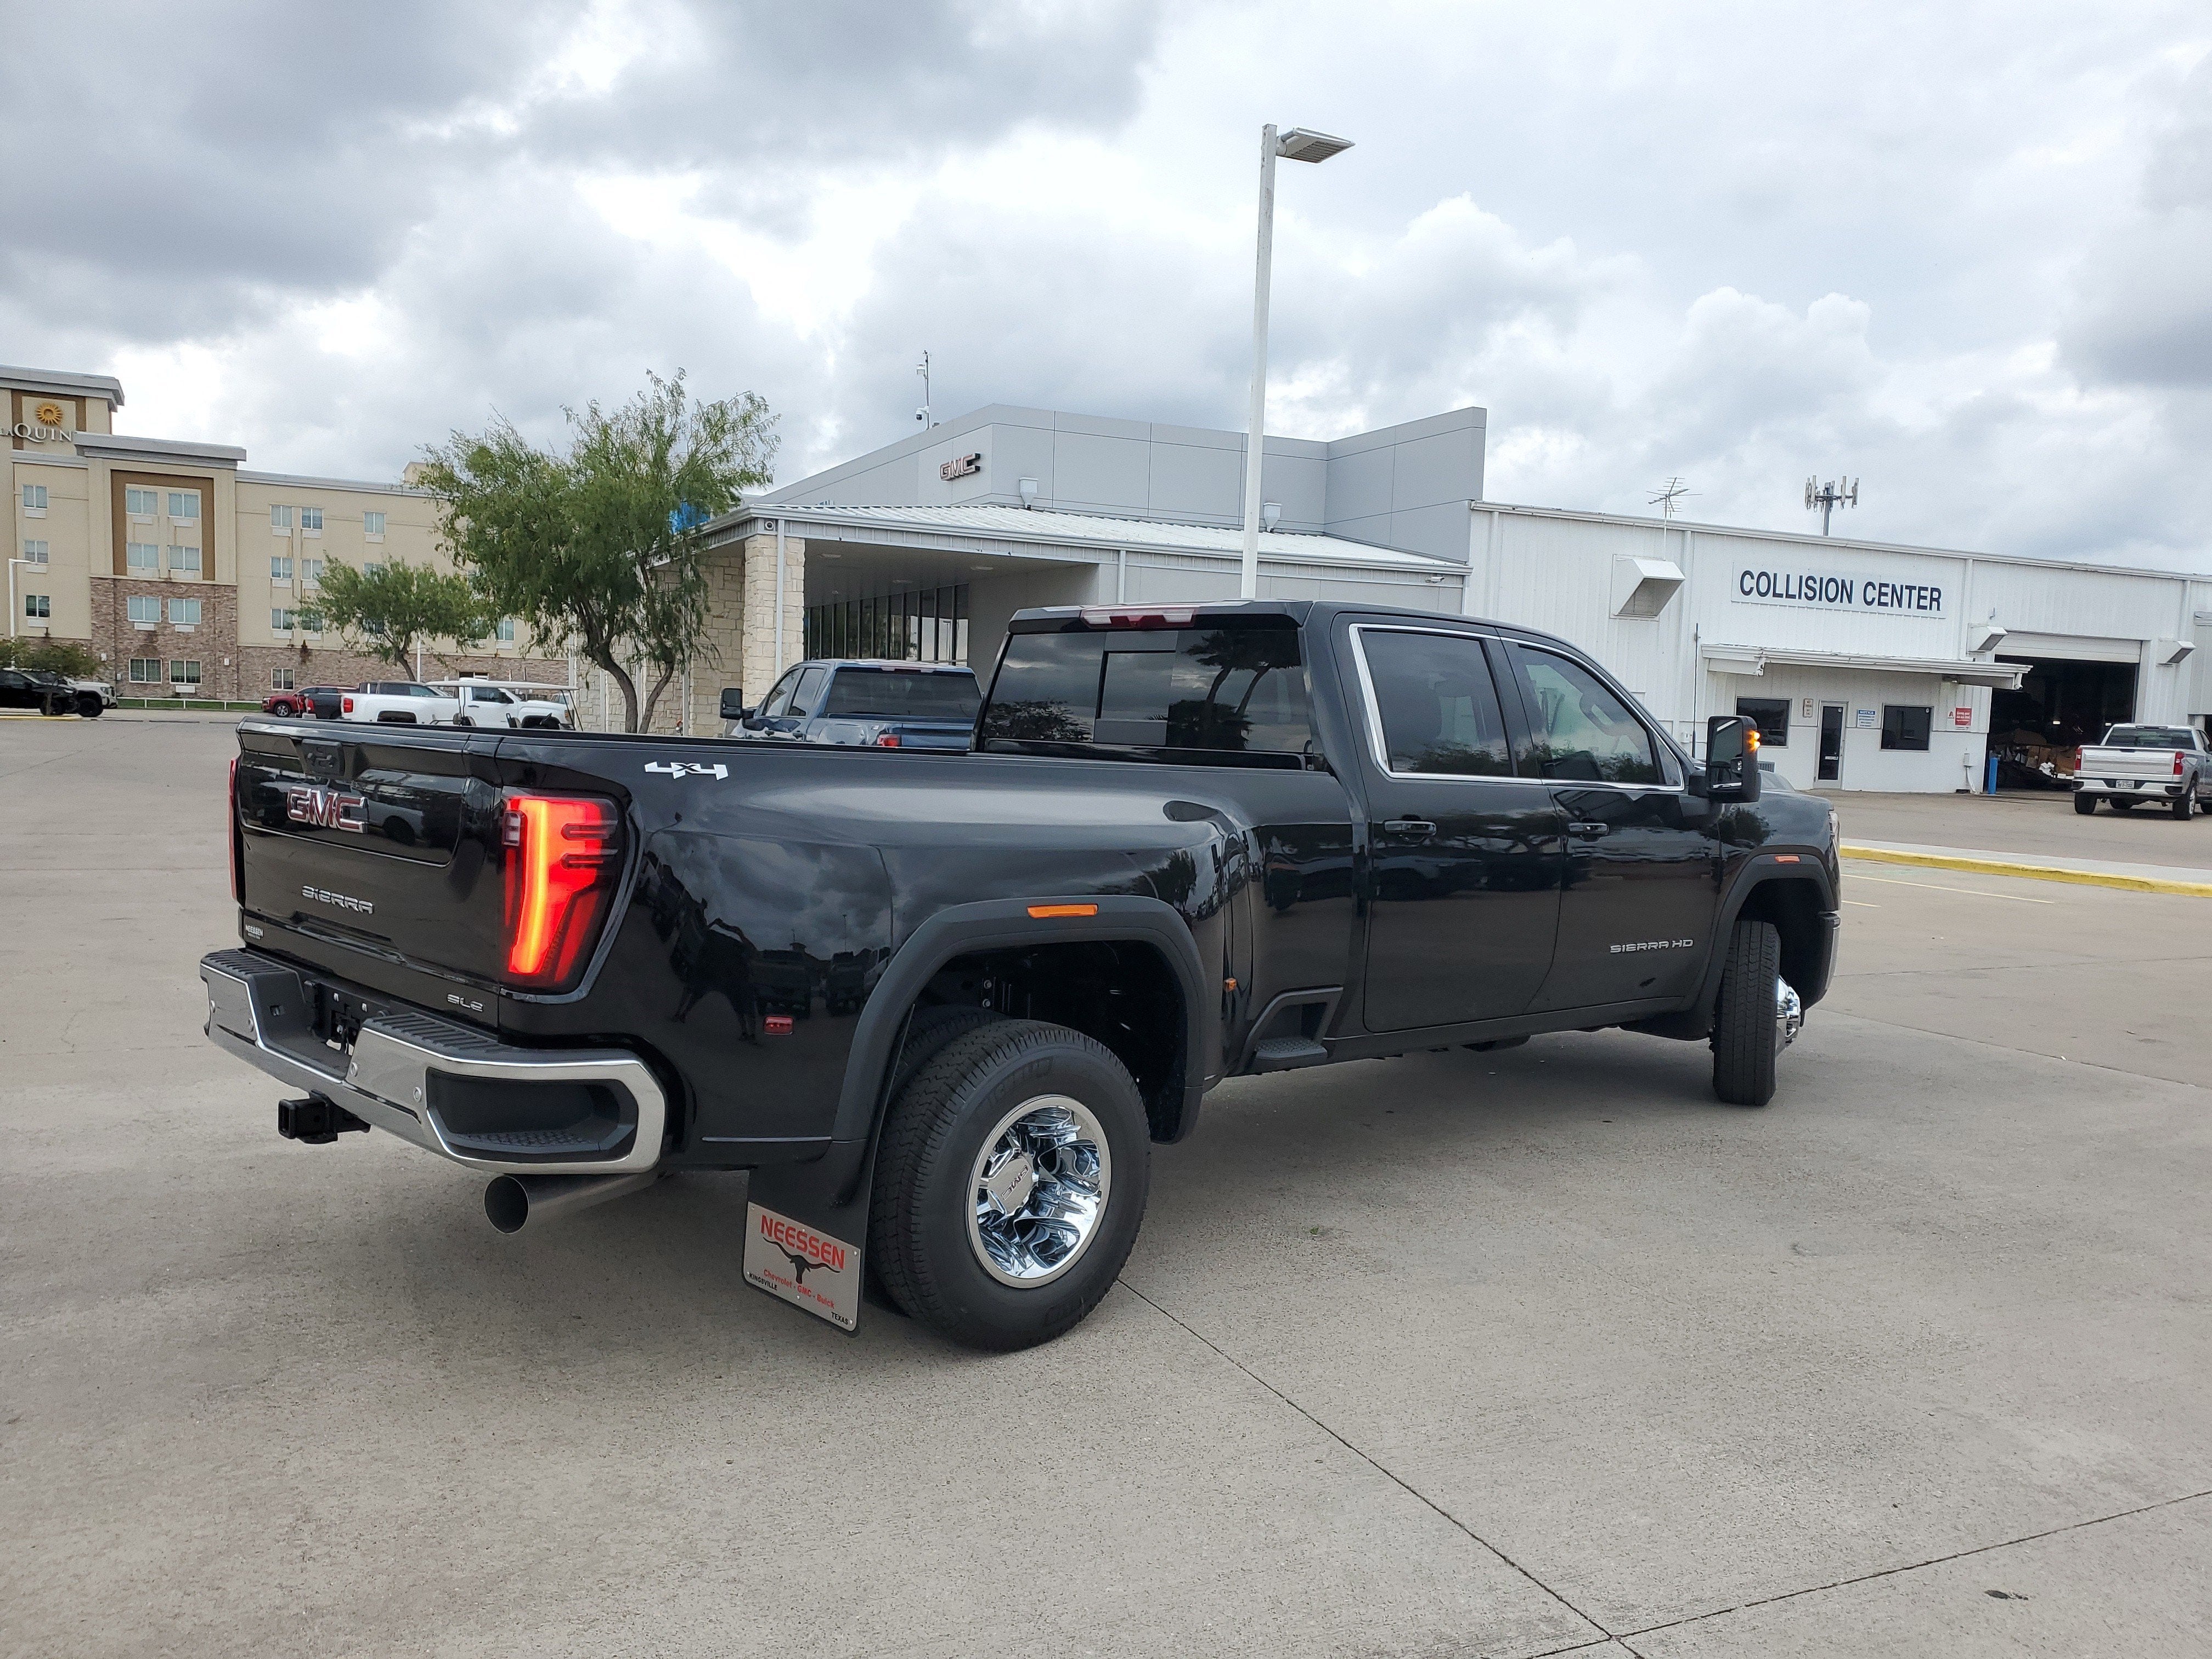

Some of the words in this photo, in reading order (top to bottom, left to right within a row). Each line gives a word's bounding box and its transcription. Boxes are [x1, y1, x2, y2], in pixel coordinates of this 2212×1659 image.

[14, 422, 72, 443] QUIN
[940, 453, 980, 481] GMC
[1740, 570, 1854, 603] COLLISION
[1863, 582, 1942, 611] CENTER
[287, 786, 369, 834] GMC
[302, 885, 374, 914] SIERRA
[1610, 941, 1669, 953] SIERRA
[1672, 939, 1694, 948] HD
[447, 994, 483, 1012] SLE
[761, 1214, 845, 1270] NEESSEN
[749, 1272, 778, 1291] KINGSVILLE
[764, 1269, 792, 1288] Chevrolet
[797, 1285, 812, 1297] GMC
[816, 1294, 834, 1309] Buick
[831, 1311, 849, 1325] TEXAS
